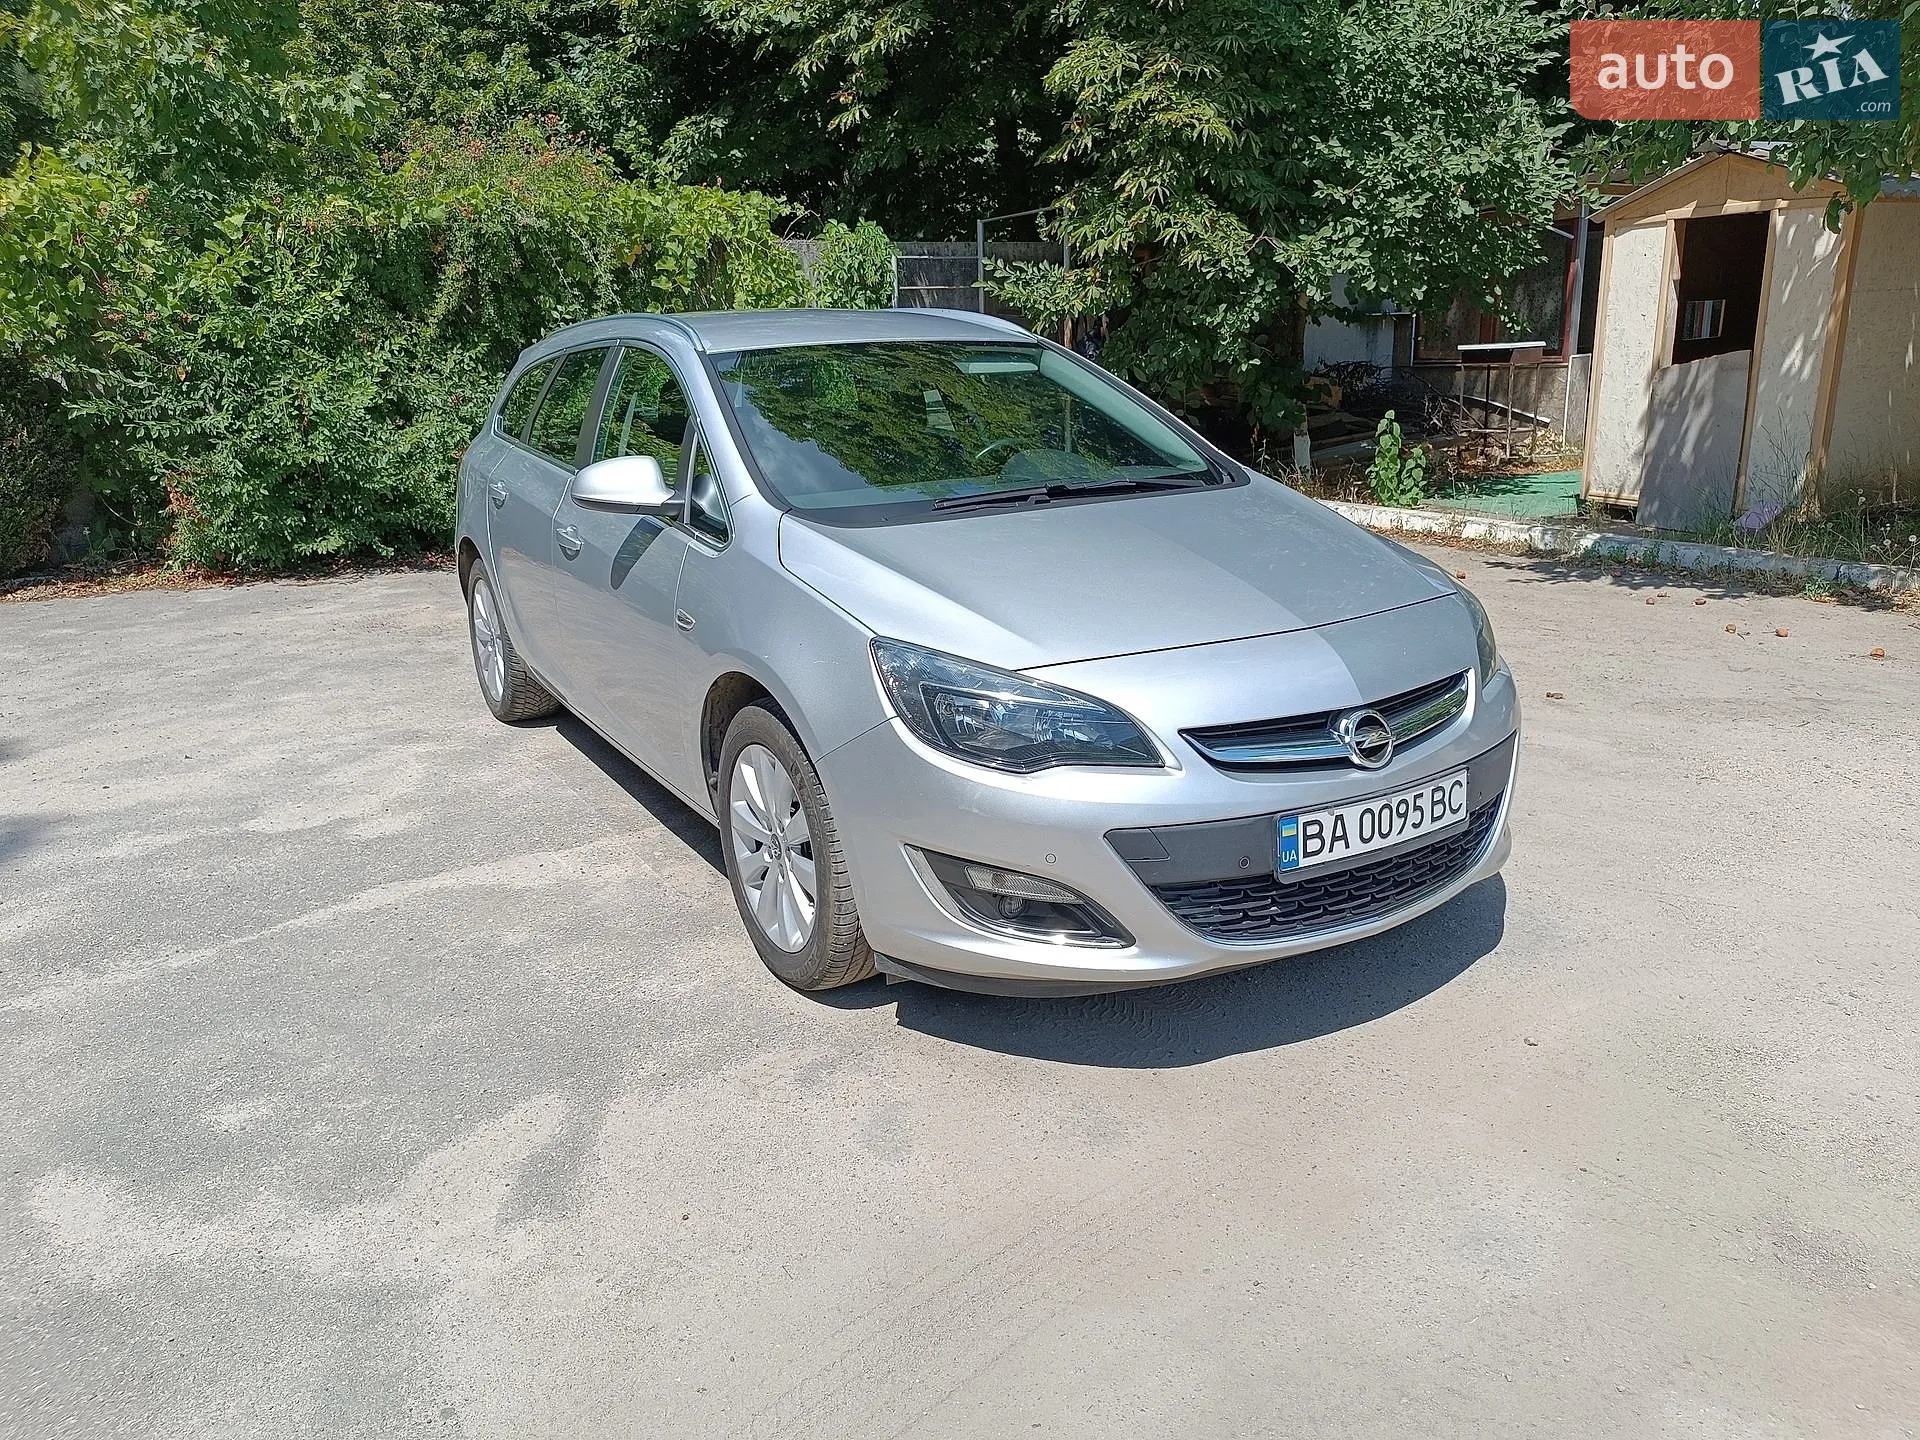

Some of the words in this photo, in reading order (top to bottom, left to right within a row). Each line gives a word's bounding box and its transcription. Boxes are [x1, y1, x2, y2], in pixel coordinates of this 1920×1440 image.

[1302, 814, 1350, 859] BA
[1358, 792, 1424, 844] 0095
[1430, 779, 1463, 824] BC
[1282, 850, 1298, 863] UA
